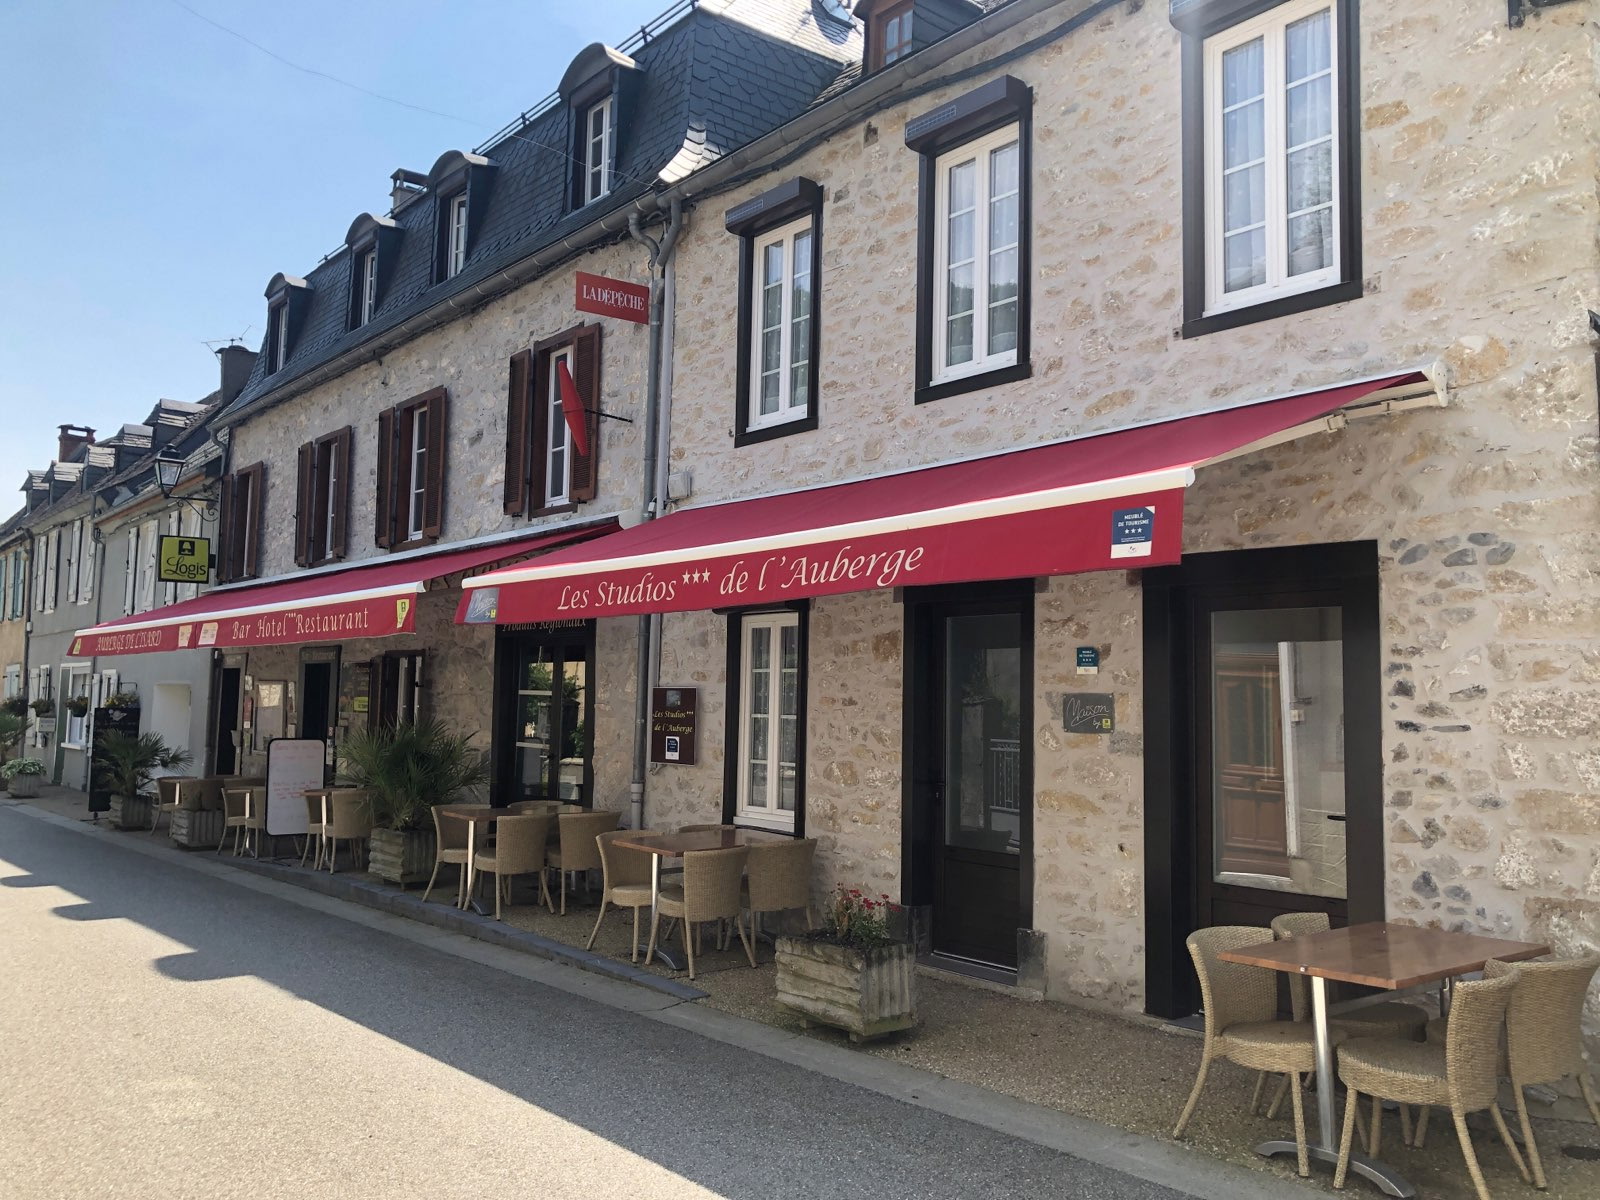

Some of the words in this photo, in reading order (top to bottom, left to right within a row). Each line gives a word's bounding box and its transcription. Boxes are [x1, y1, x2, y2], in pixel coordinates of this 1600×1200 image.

[583, 284, 597, 301] LA
[597, 287, 645, 311] DÉPÊCHE
[164, 556, 206, 579] Logis
[557, 585, 590, 610] Les
[595, 572, 677, 607] Studios
[719, 560, 749, 595] de
[232, 620, 251, 640] Bar
[256, 612, 289, 638] Hotel
[295, 607, 369, 635] Restaurant
[95, 634, 126, 654] AUBERGE
[664, 710, 686, 718] Studios
[1067, 698, 1110, 727] Maison
[654, 723, 661, 731] de
